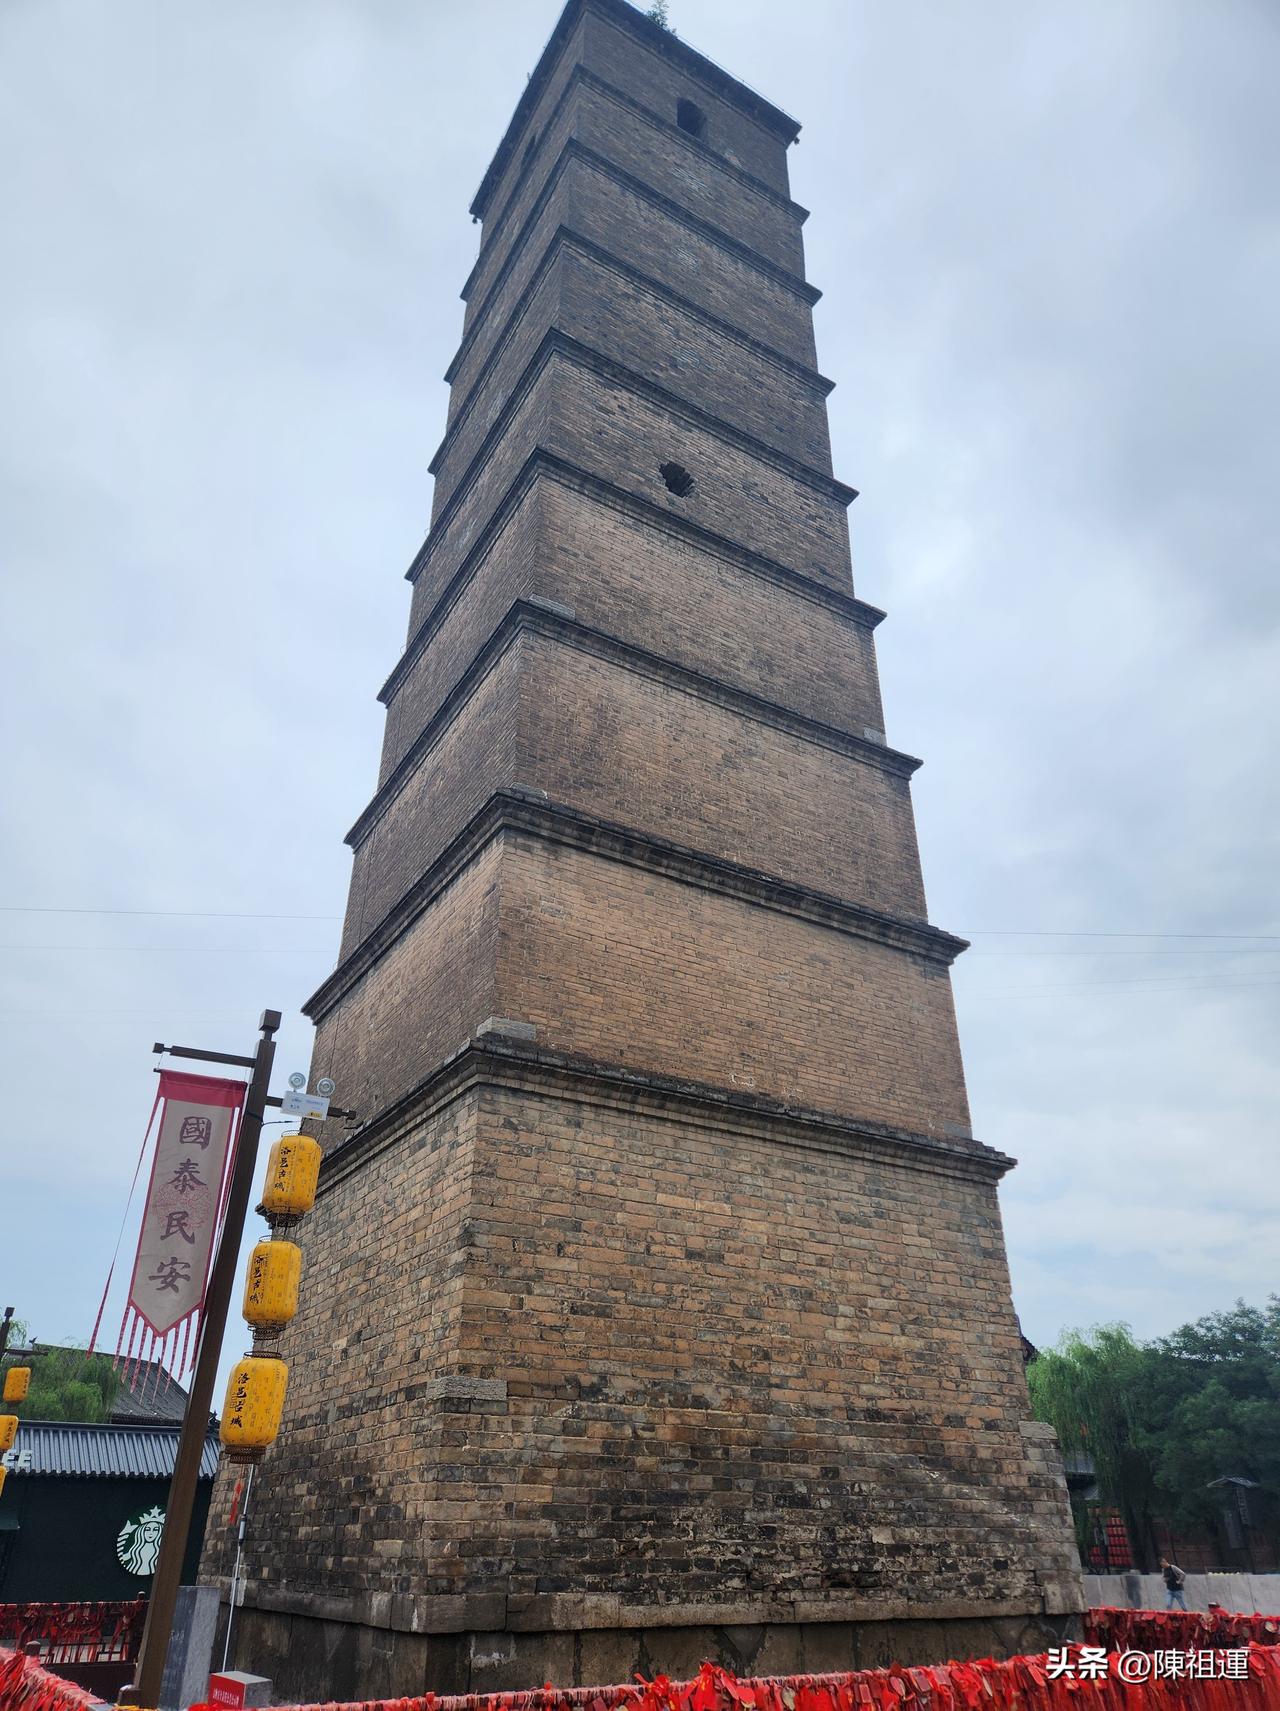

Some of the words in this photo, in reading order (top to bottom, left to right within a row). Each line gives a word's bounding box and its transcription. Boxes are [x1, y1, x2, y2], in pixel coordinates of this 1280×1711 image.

[274, 1146, 292, 1192] 洛邑古城
[148, 1116, 212, 1293] 國泰民安
[230, 1372, 250, 1428] 洛邑古城
